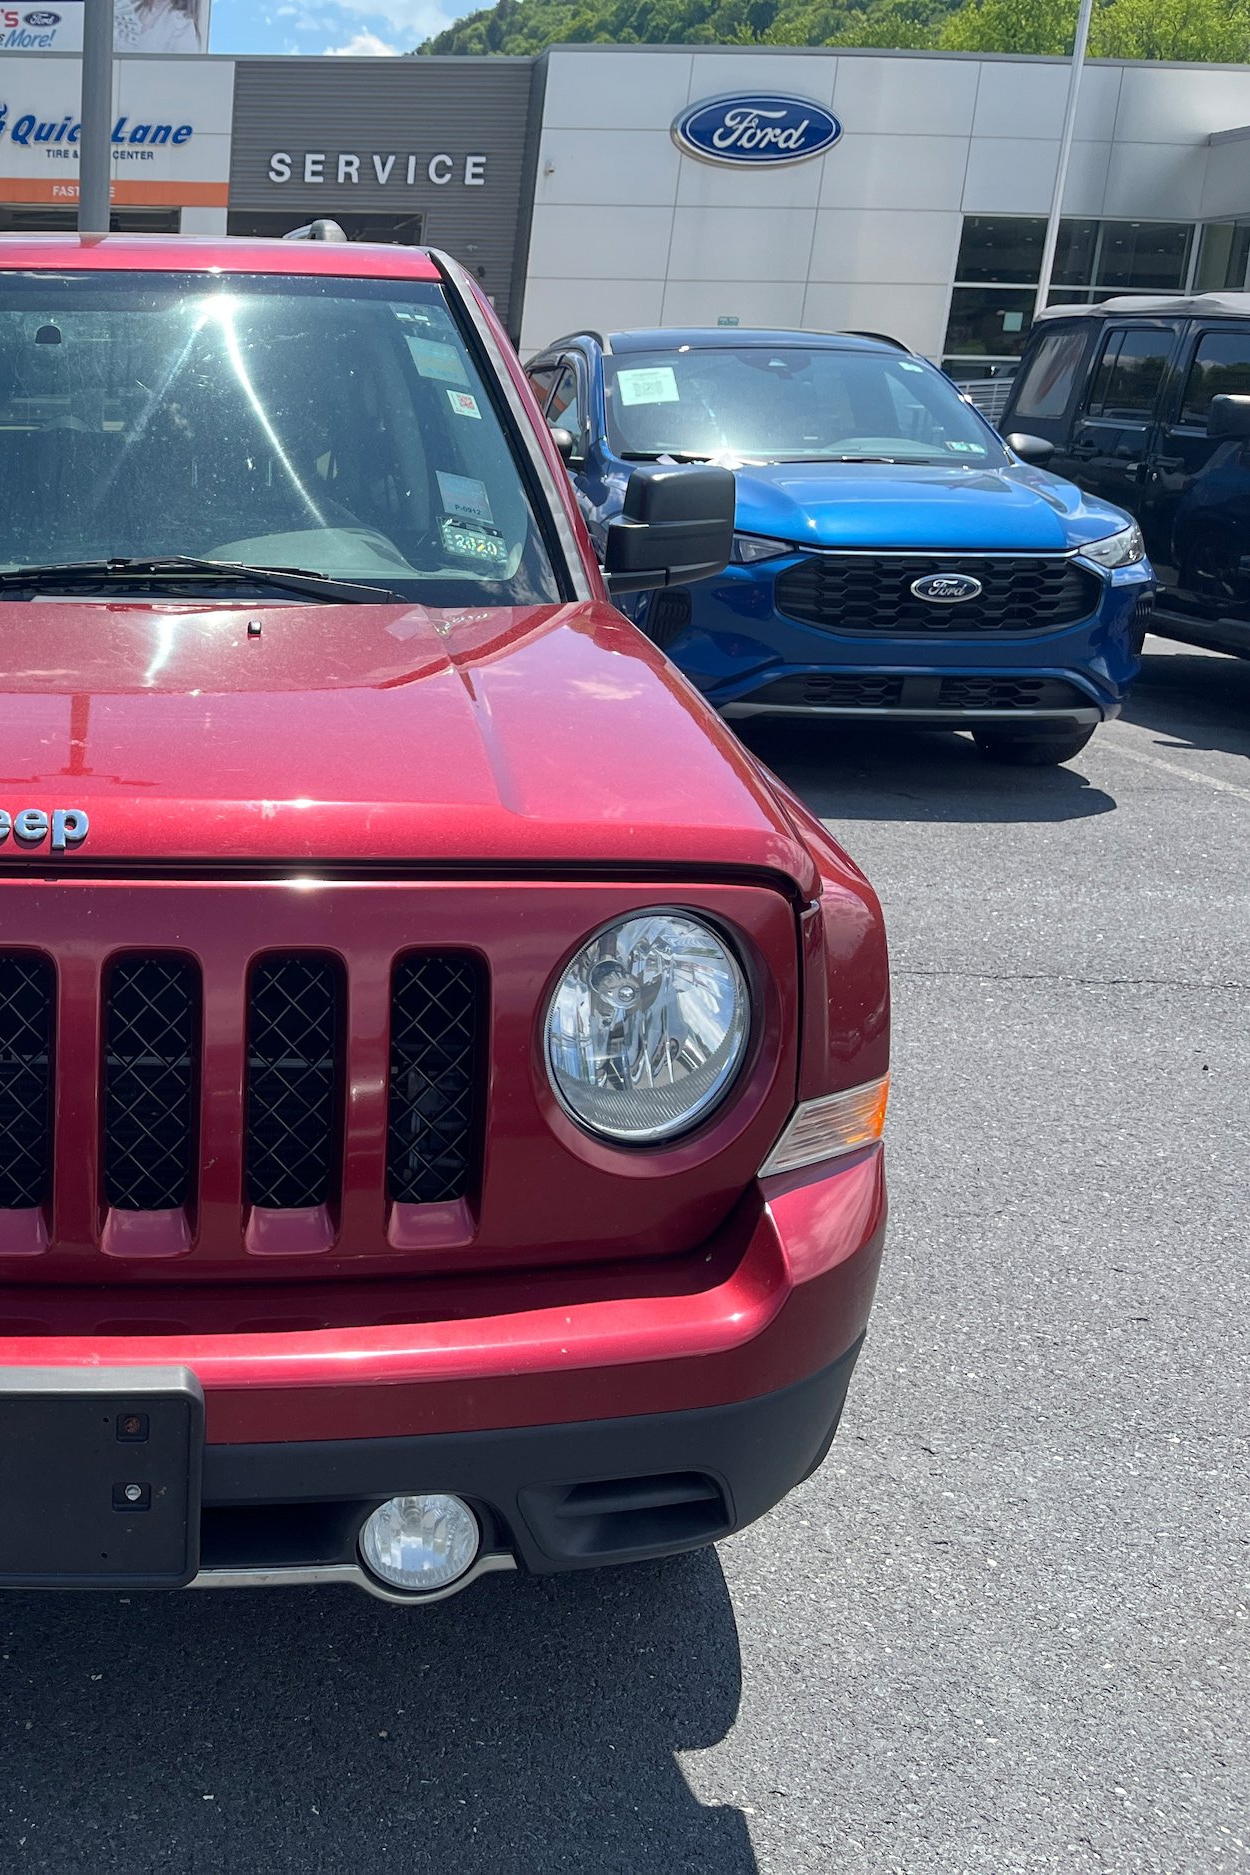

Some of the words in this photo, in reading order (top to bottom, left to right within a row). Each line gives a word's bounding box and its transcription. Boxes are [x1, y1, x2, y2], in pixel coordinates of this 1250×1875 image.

[4, 29, 57, 48] More!
[11, 114, 82, 145] Quic
[111, 116, 193, 144] Lane
[712, 108, 810, 149] Ford
[46, 149, 69, 159] TIRE
[73, 150, 79, 159] &
[112, 150, 154, 160] CENTER
[268, 152, 487, 185] SERVICE
[928, 579, 967, 596] Ford
